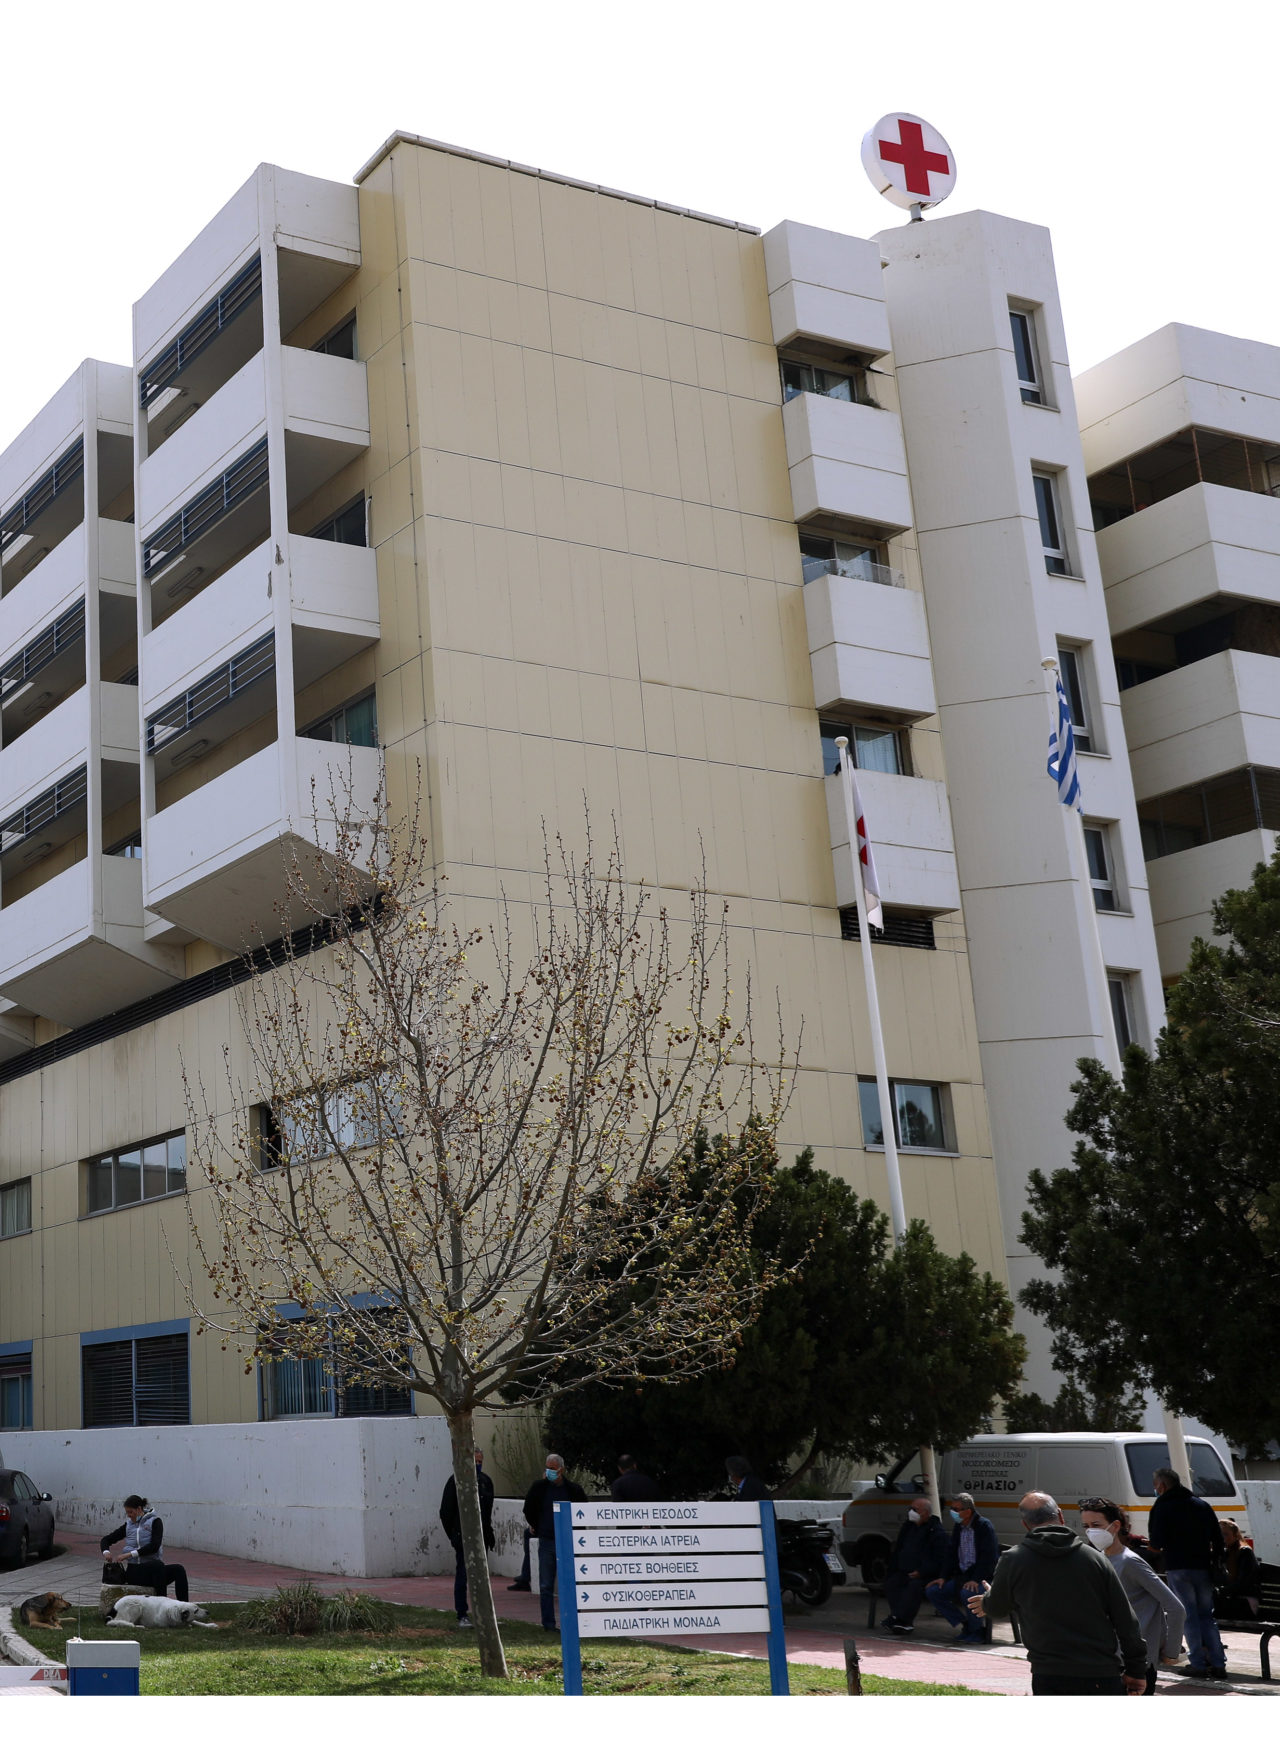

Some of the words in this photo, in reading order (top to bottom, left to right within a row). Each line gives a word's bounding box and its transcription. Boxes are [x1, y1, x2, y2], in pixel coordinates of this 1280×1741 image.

[596, 1508, 649, 1519] ΚΕΝΤΡΙΚΗ
[652, 1508, 699, 1519] ΕΙΣΟΔΟΣ
[598, 1535, 658, 1547] ΕΞΩΤΕΡΙΚΑ
[661, 1535, 701, 1546] ΙΑΤΡΕΙΑ
[600, 1563, 642, 1574] ΠΡΩΤΕΣ
[646, 1562, 699, 1573] ΒΟΗΘΕΙΕΣ
[602, 1590, 696, 1602] ΦΥΣΙΚΟΘΕΡΑΠΕΙΑ
[603, 1617, 670, 1630] ΠΑΙΔΙΑΤΡΙΚΗ
[673, 1616, 721, 1628] ΜΟΝΑΔΑ
